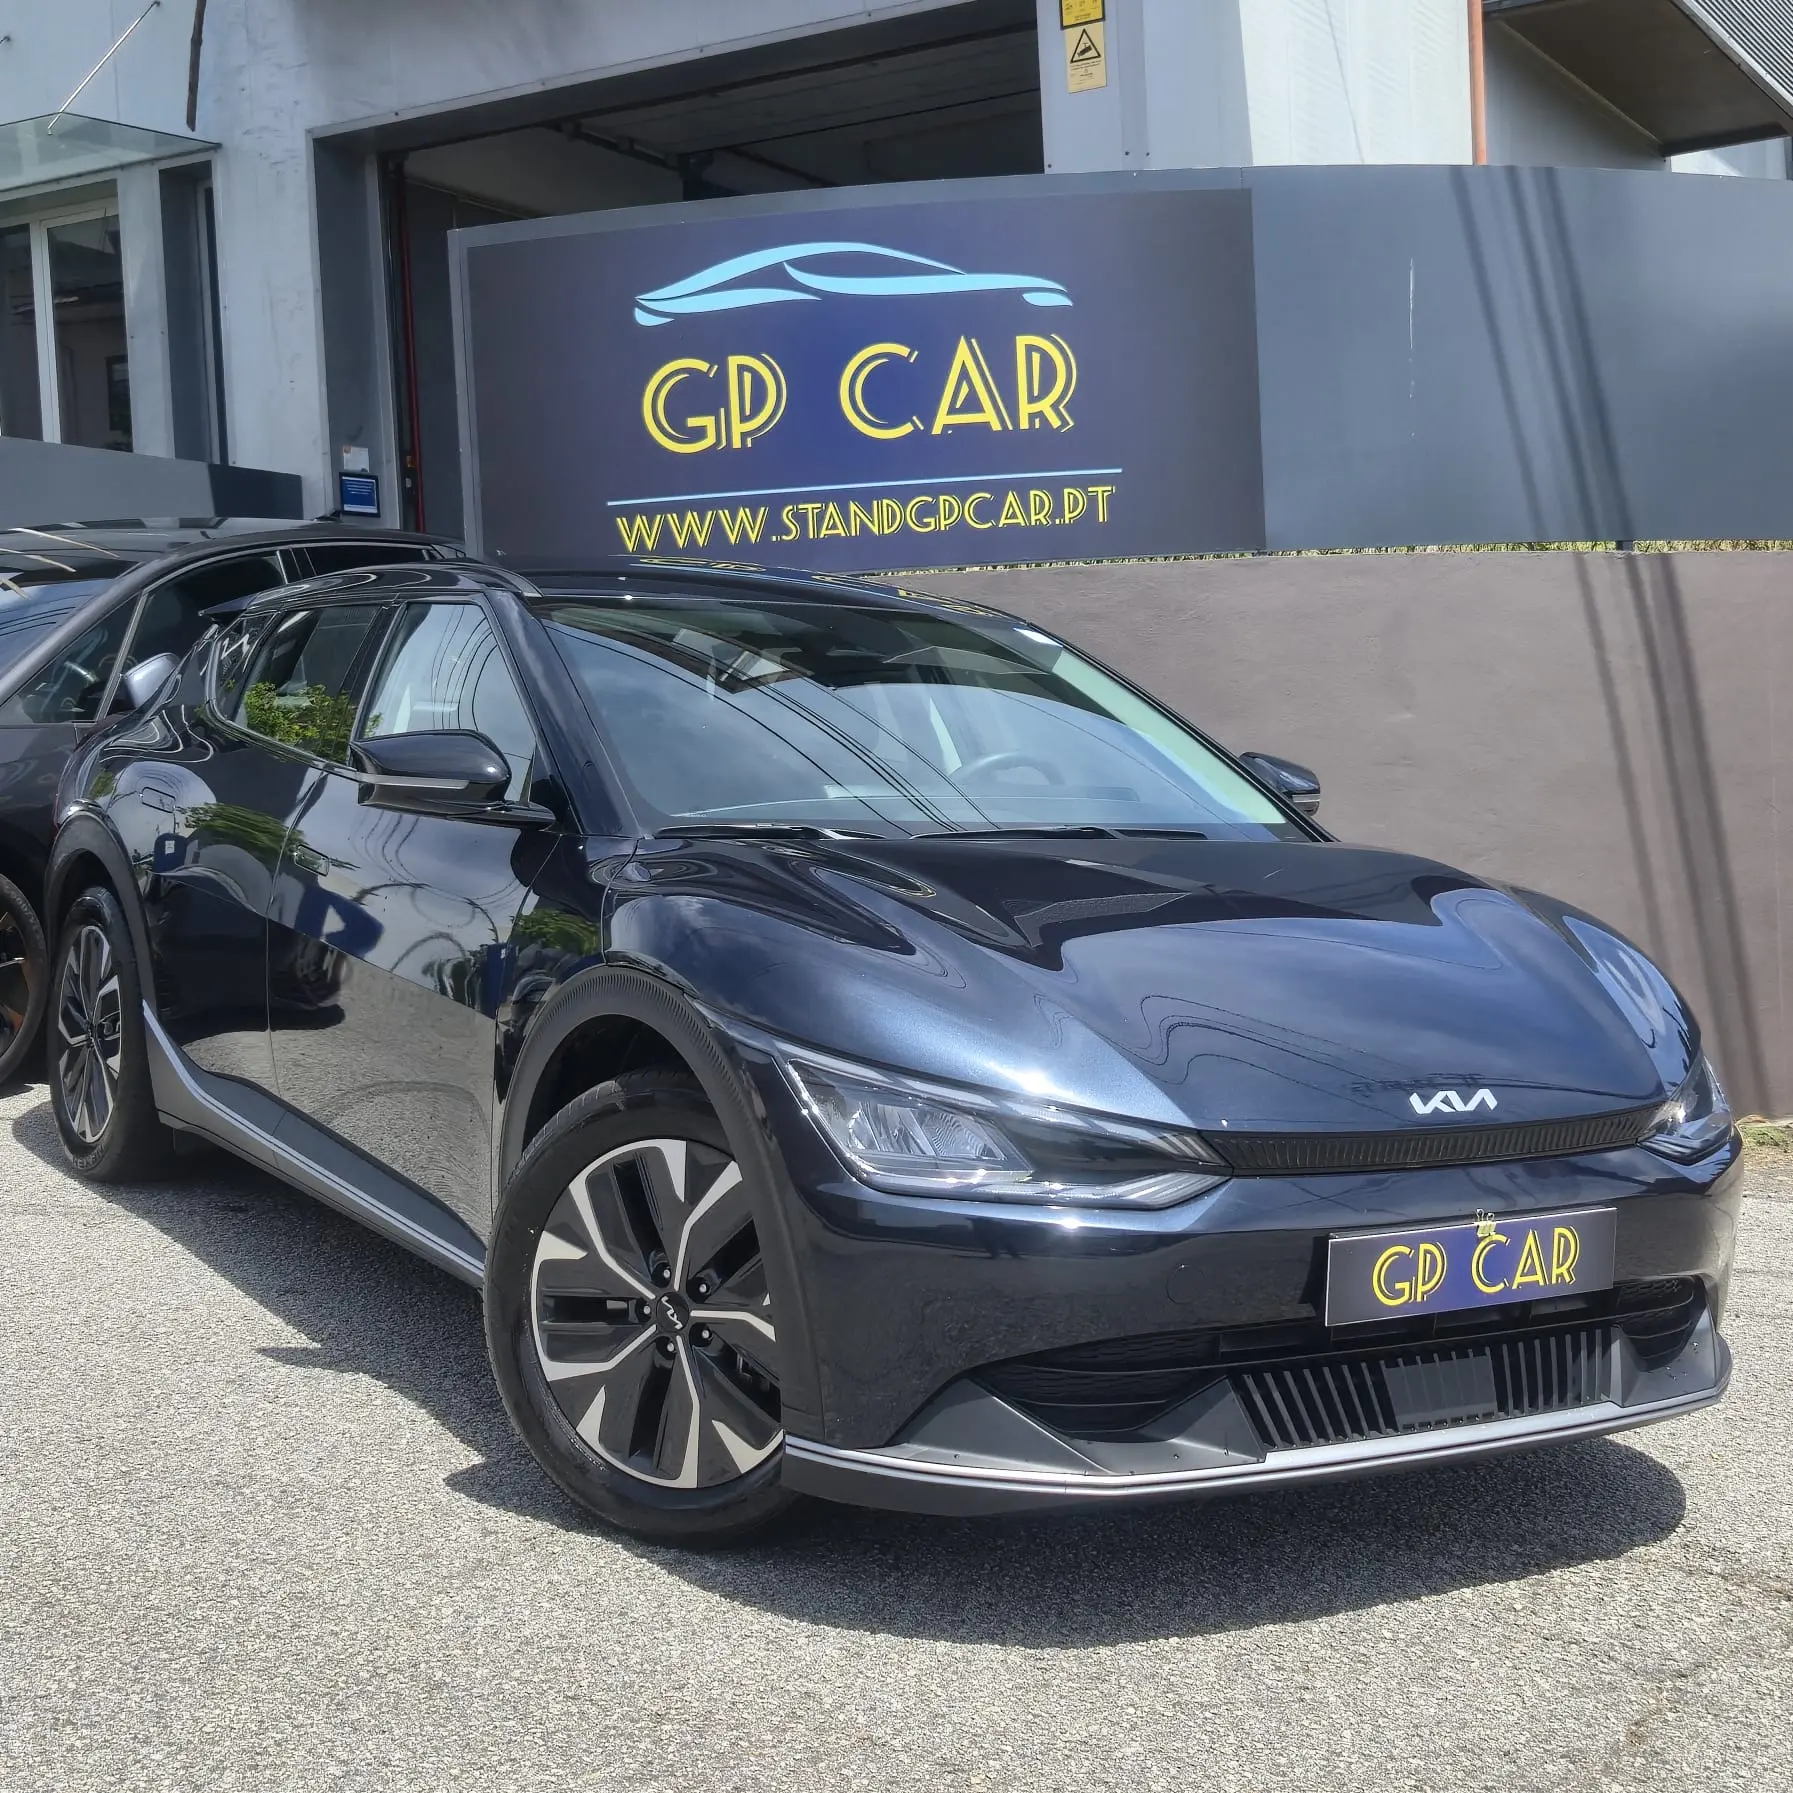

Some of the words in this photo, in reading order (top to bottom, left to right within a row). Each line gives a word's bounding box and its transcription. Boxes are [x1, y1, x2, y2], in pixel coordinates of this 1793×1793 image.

[641, 352, 788, 455] GP
[839, 333, 1078, 441] CAR
[1371, 1241, 1447, 1307] GP
[1470, 1225, 1581, 1294] CAR
